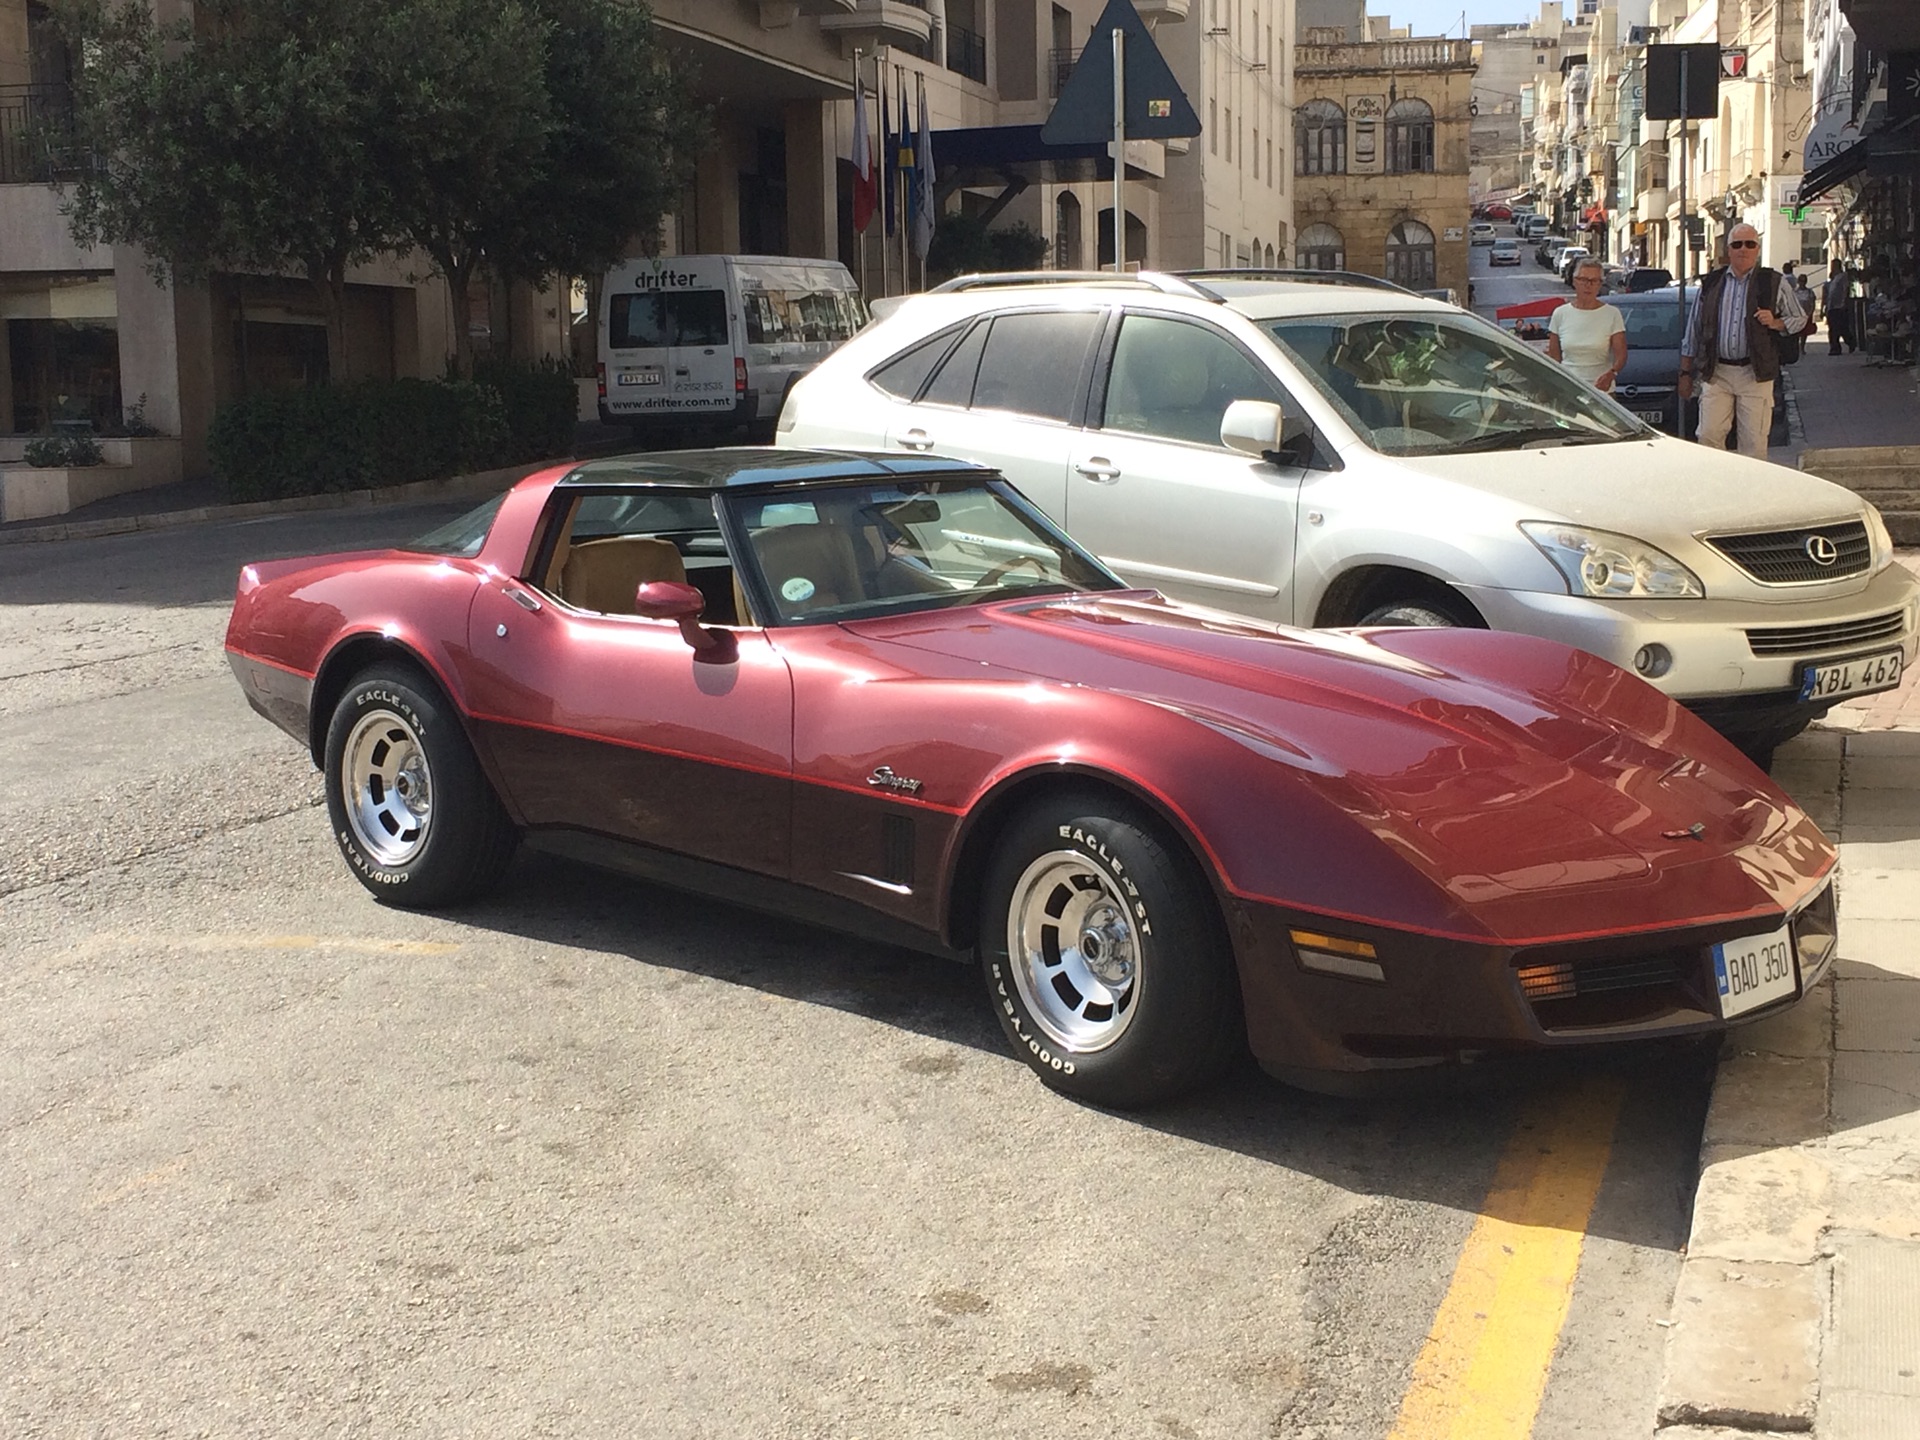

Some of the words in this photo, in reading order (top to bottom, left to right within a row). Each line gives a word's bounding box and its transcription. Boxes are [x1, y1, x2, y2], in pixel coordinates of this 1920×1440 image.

[1809, 140, 1855, 158] ARC
[635, 270, 697, 288] drifter
[612, 397, 731, 410] www.drifter.com.mt
[1862, 655, 1898, 687] 462
[356, 690, 401, 707] EAGLE
[866, 765, 922, 794] Stingray
[340, 830, 409, 885] GOODYEAR
[1059, 825, 1123, 875] EAGLE
[1135, 900, 1152, 936] ST
[1729, 952, 1759, 996] BAD
[1761, 941, 1789, 983] 350
[991, 962, 1076, 1076] GOODYEAR
